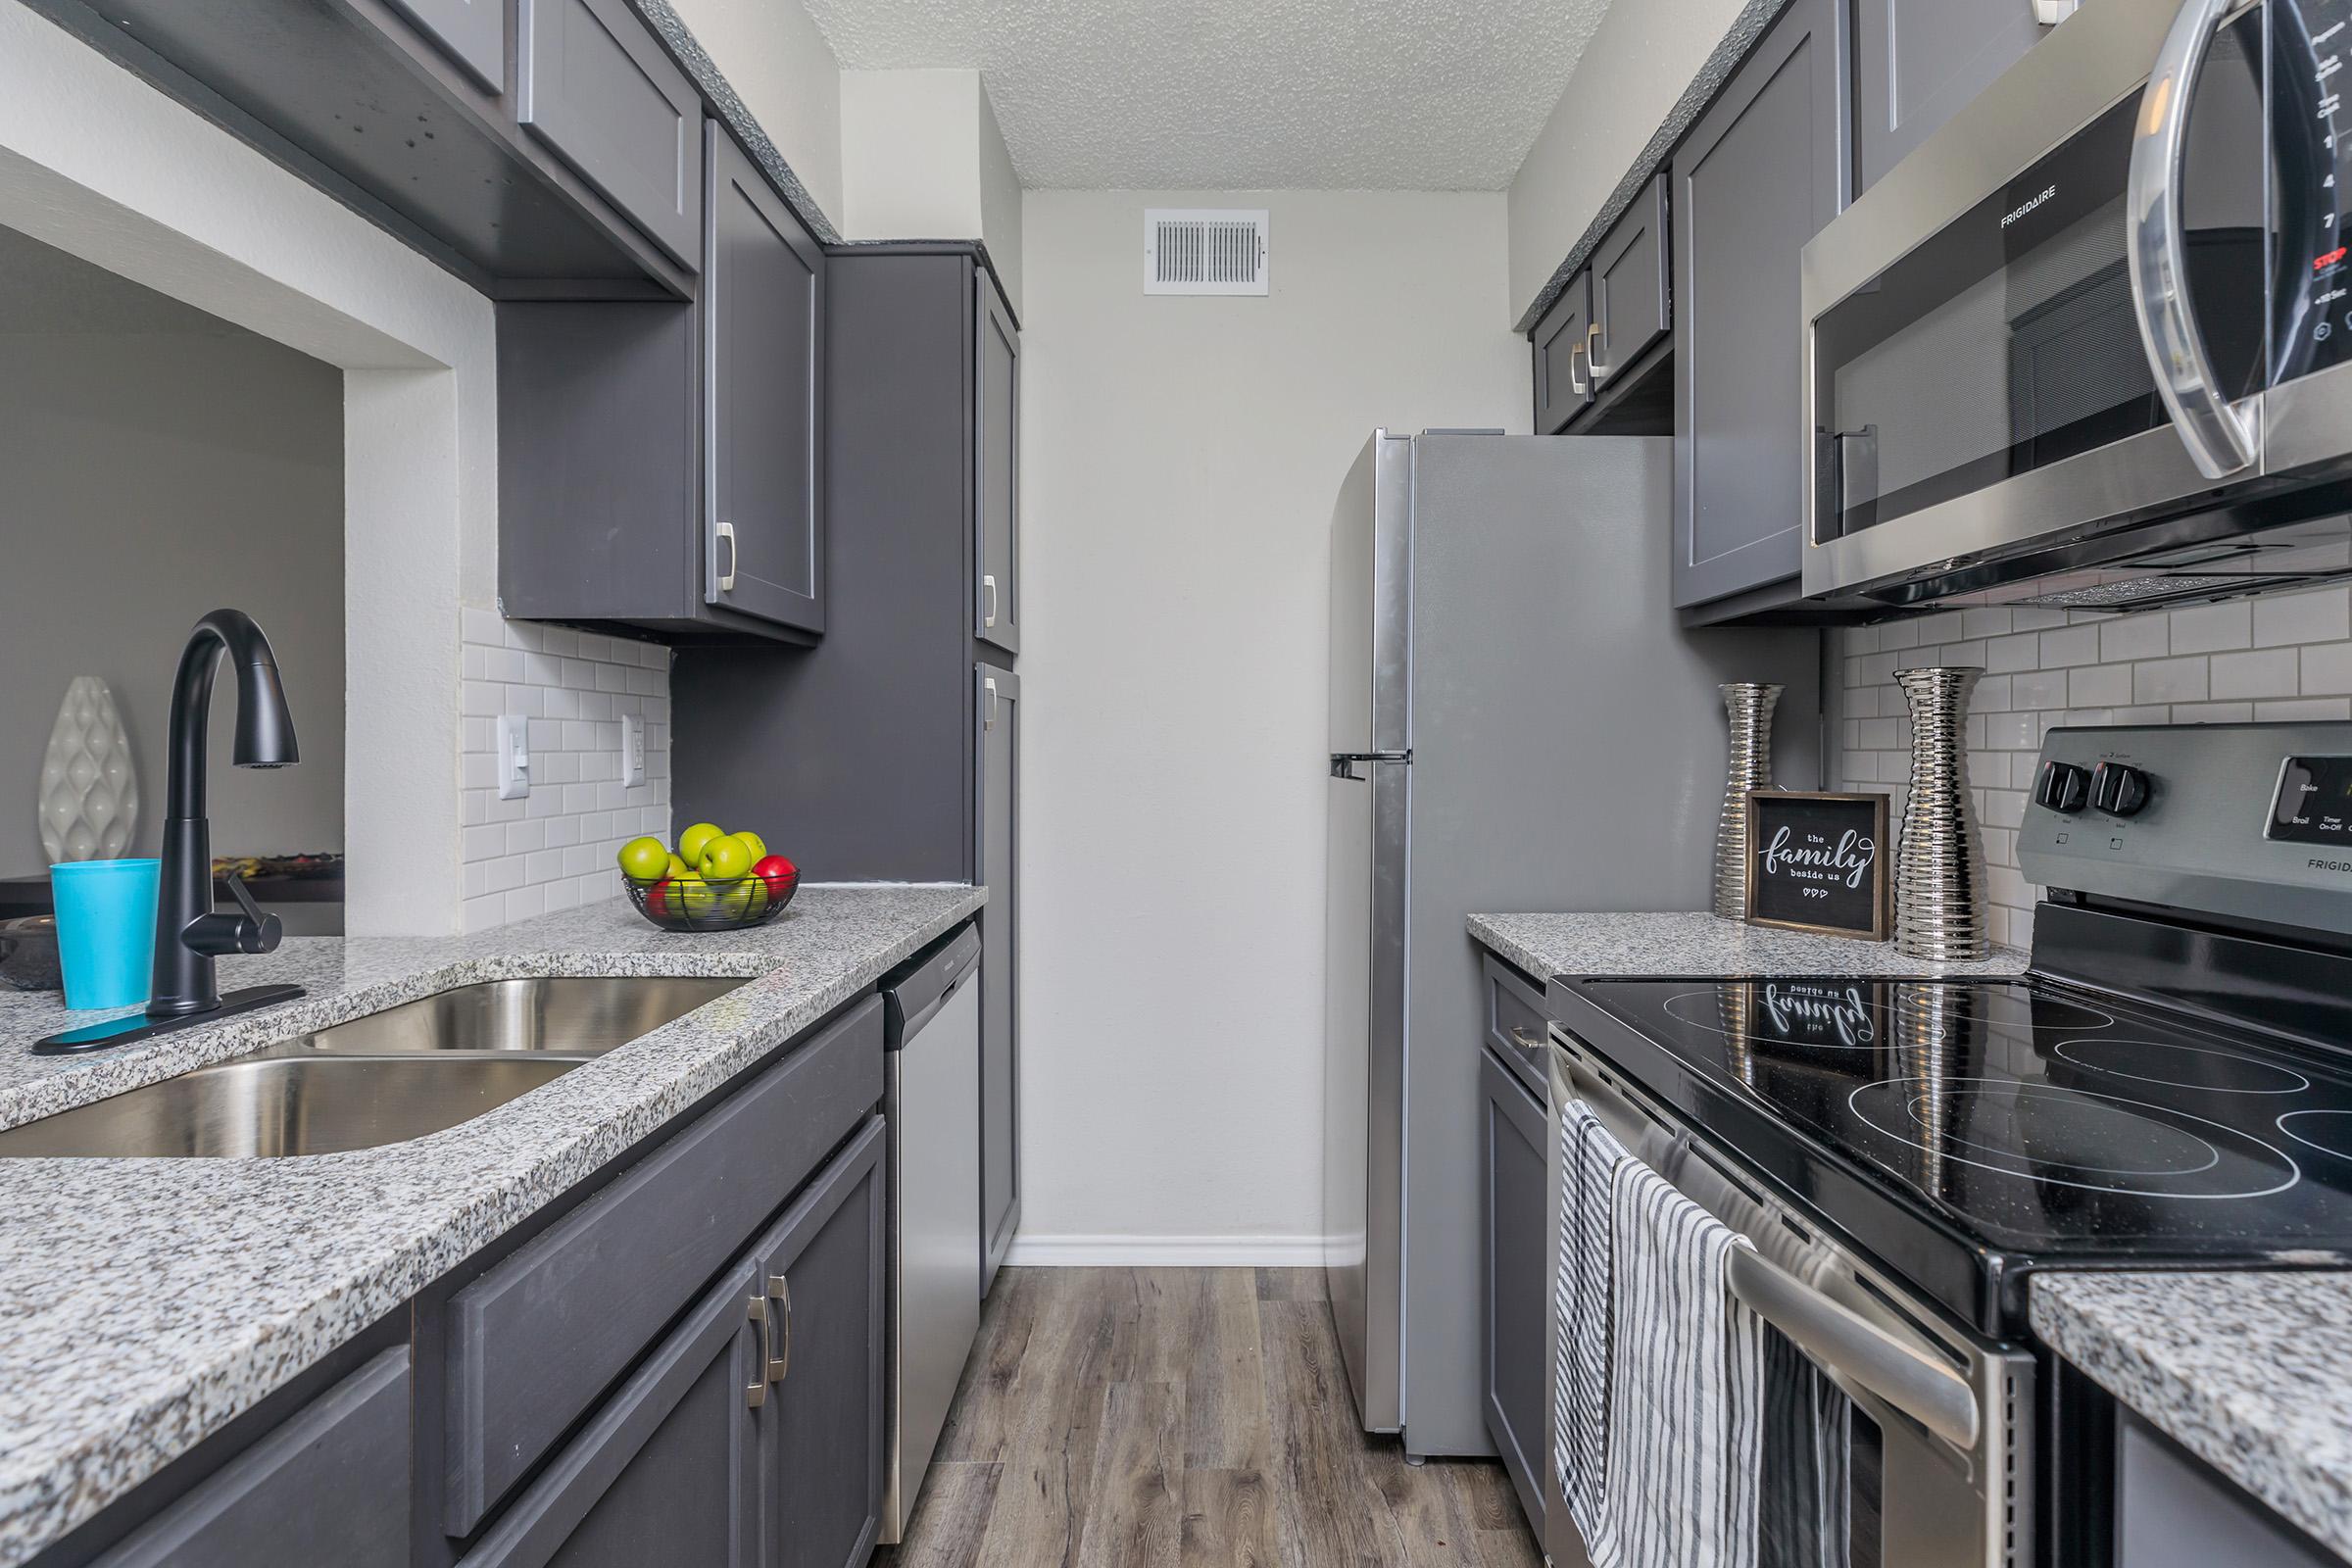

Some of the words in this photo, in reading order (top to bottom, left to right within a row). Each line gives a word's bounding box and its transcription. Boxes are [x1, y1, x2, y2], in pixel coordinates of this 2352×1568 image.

[2324, 135, 2332, 149] 1
[2323, 173, 2335, 188] 4
[2000, 184, 2056, 229] FRIGIDAIRE
[2324, 213, 2335, 228] 7
[2314, 247, 2347, 270] STOP
[2300, 783, 2319, 792] Bake
[2292, 815, 2310, 824] Broil
[1807, 834, 1825, 844] the
[1758, 825, 1875, 889] family
[2307, 858, 2352, 872] FRIGID
[1789, 868, 1824, 880] beside
[1827, 872, 1840, 881] us
